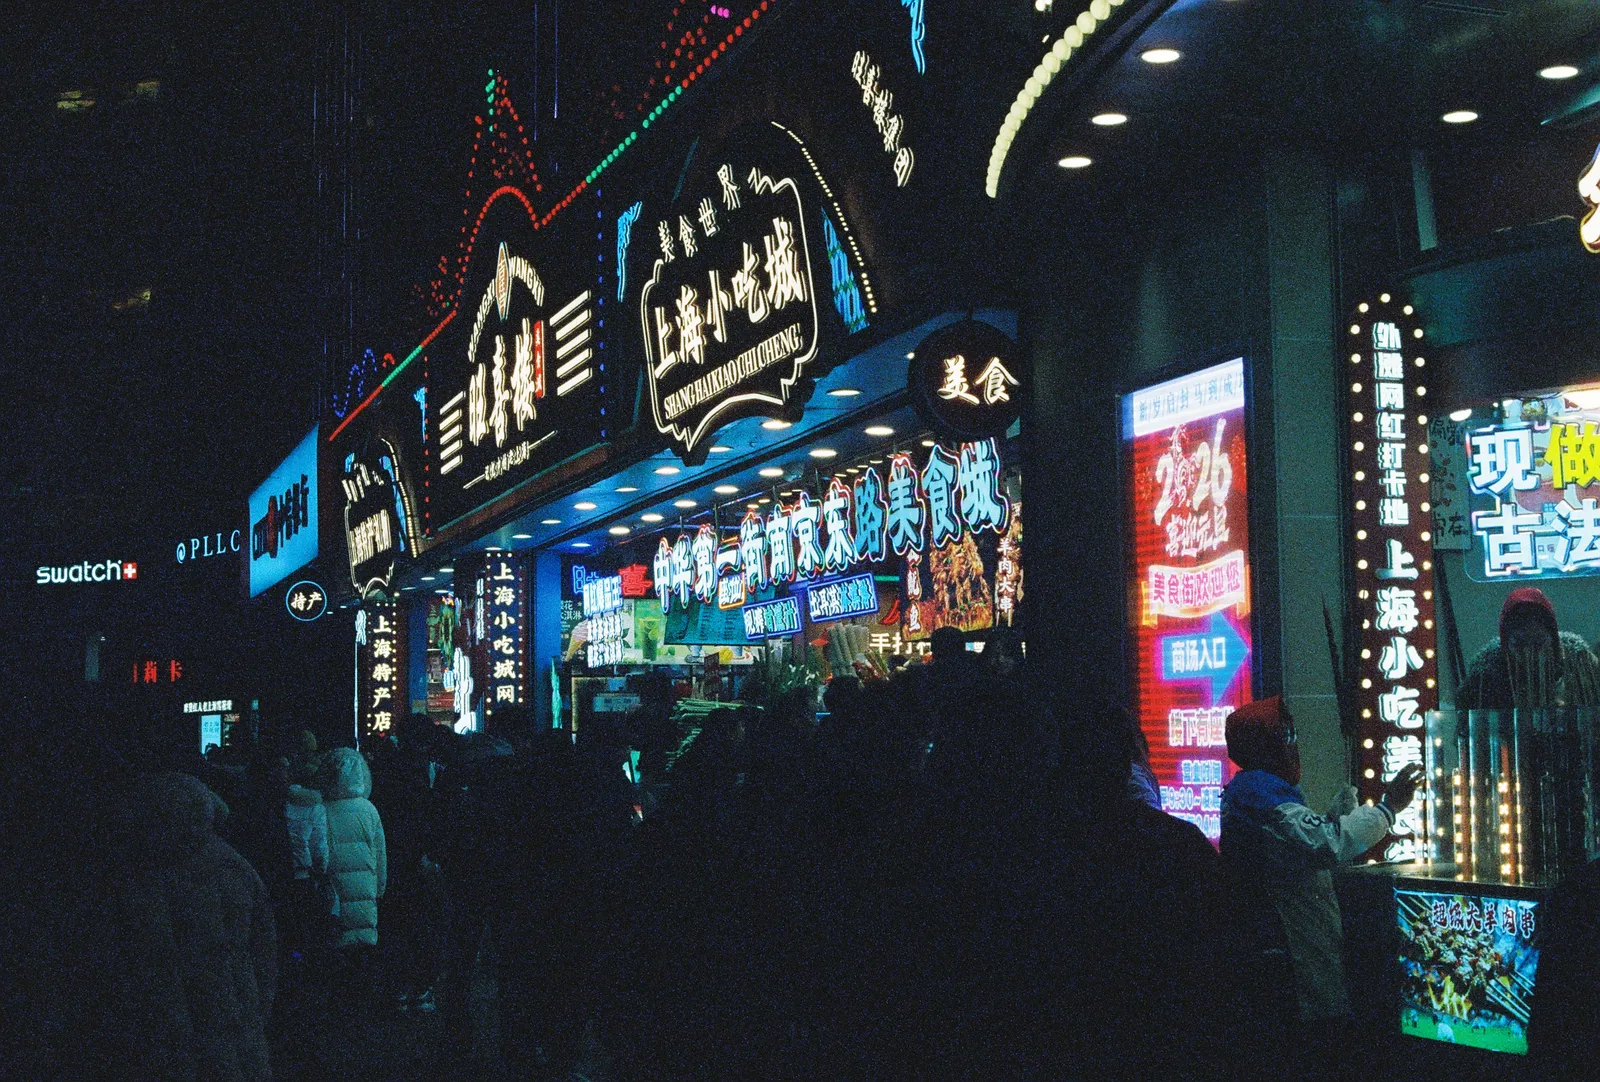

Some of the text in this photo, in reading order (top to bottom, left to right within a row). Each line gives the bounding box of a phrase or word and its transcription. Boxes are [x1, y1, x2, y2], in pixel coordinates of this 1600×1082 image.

[657, 163, 741, 262] 美食世界
[654, 216, 808, 380] 上海小吃城
[936, 354, 1020, 405] 美食
[1372, 321, 1409, 527] 外滩网红打卡地
[654, 438, 1009, 612] 中华第一街南京东路美食城
[1165, 505, 1230, 557] 喜迎元旦
[36, 560, 123, 584] swatch
[290, 591, 323, 611] 特产
[996, 538, 1015, 612] 羊肉大串
[1153, 558, 1241, 606] 美食街欢迎您
[493, 562, 516, 704] 上海小吃城网
[1171, 636, 1226, 675] 商场入口
[372, 614, 393, 732] 上海特产店
[1431, 900, 1536, 938] 超级大羊肉串
